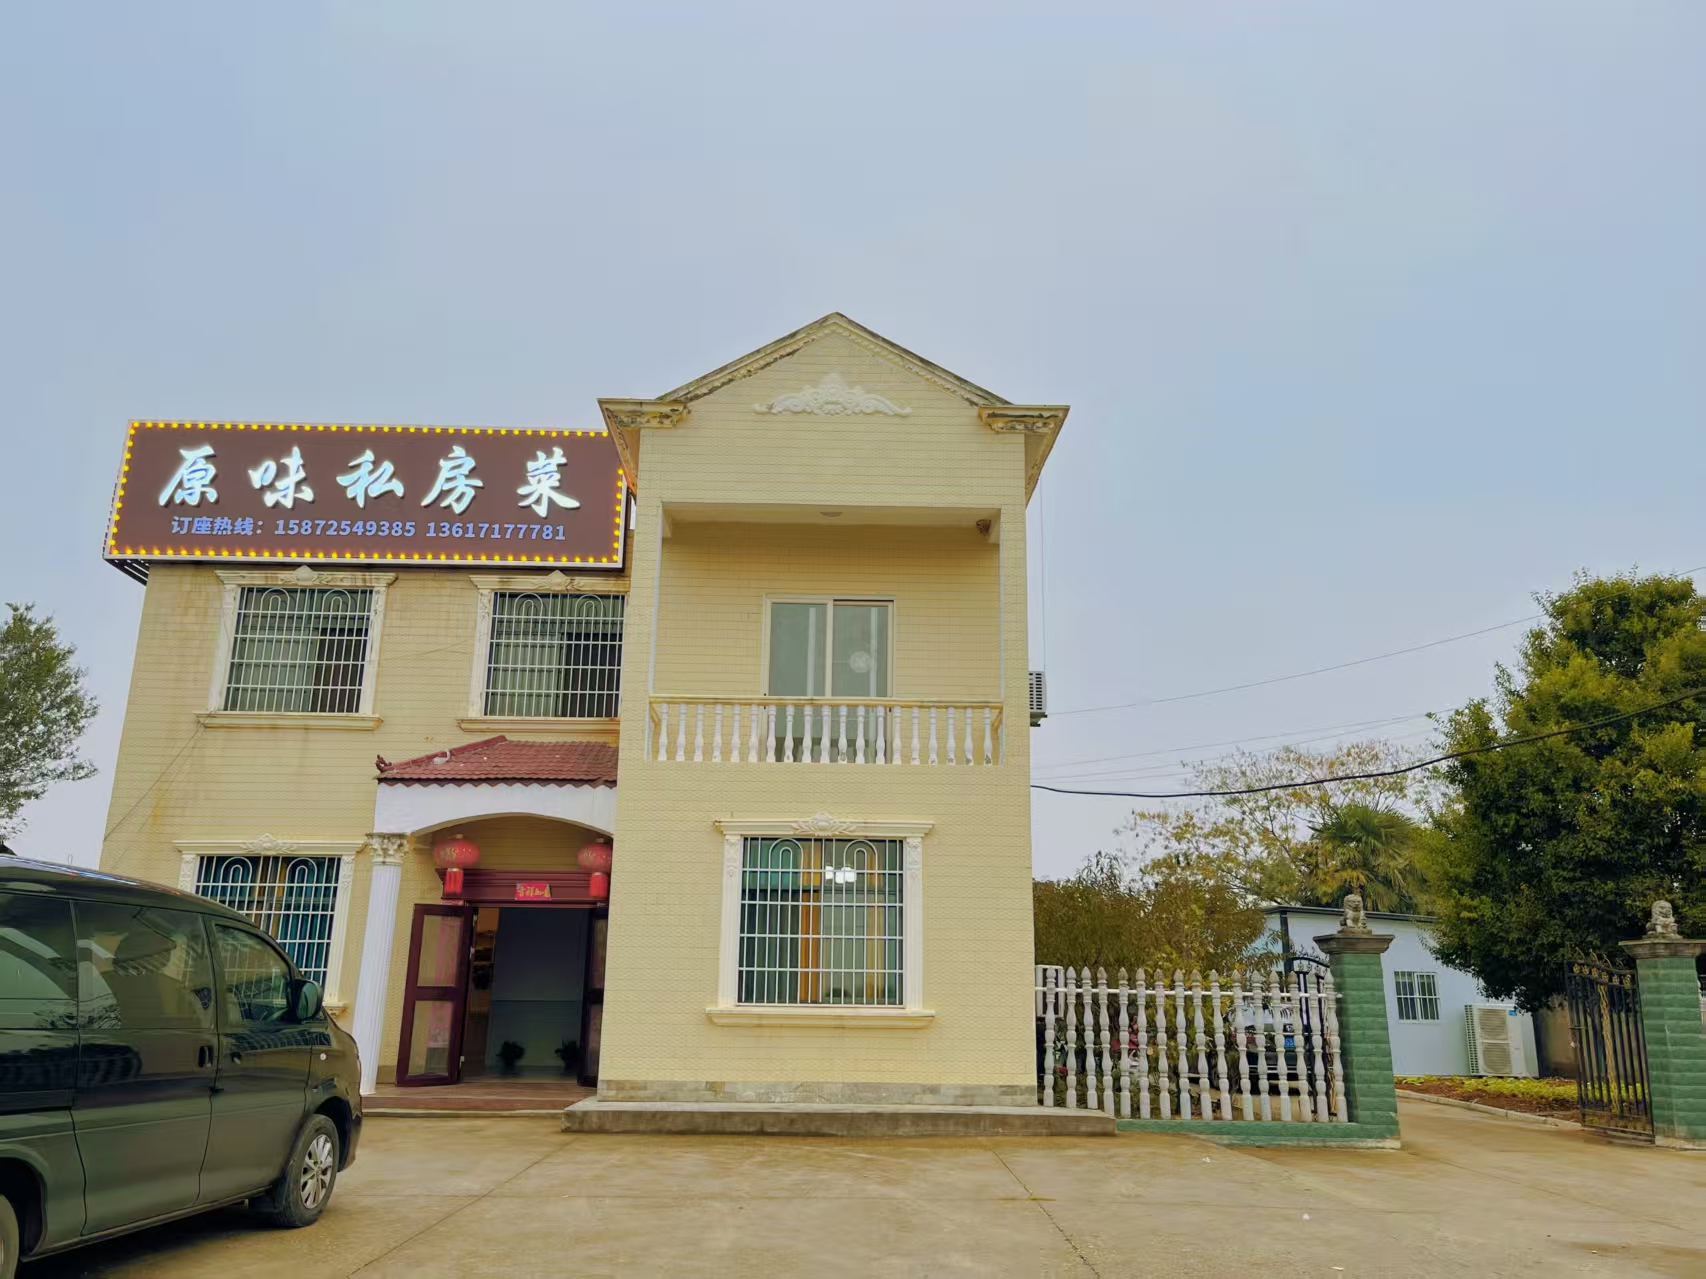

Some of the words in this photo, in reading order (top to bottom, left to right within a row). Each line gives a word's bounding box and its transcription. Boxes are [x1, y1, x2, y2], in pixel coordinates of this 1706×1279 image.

[158, 445, 581, 517] 原味私房菜
[274, 519, 416, 537] 15872549385
[426, 522, 566, 541] 13617177781
